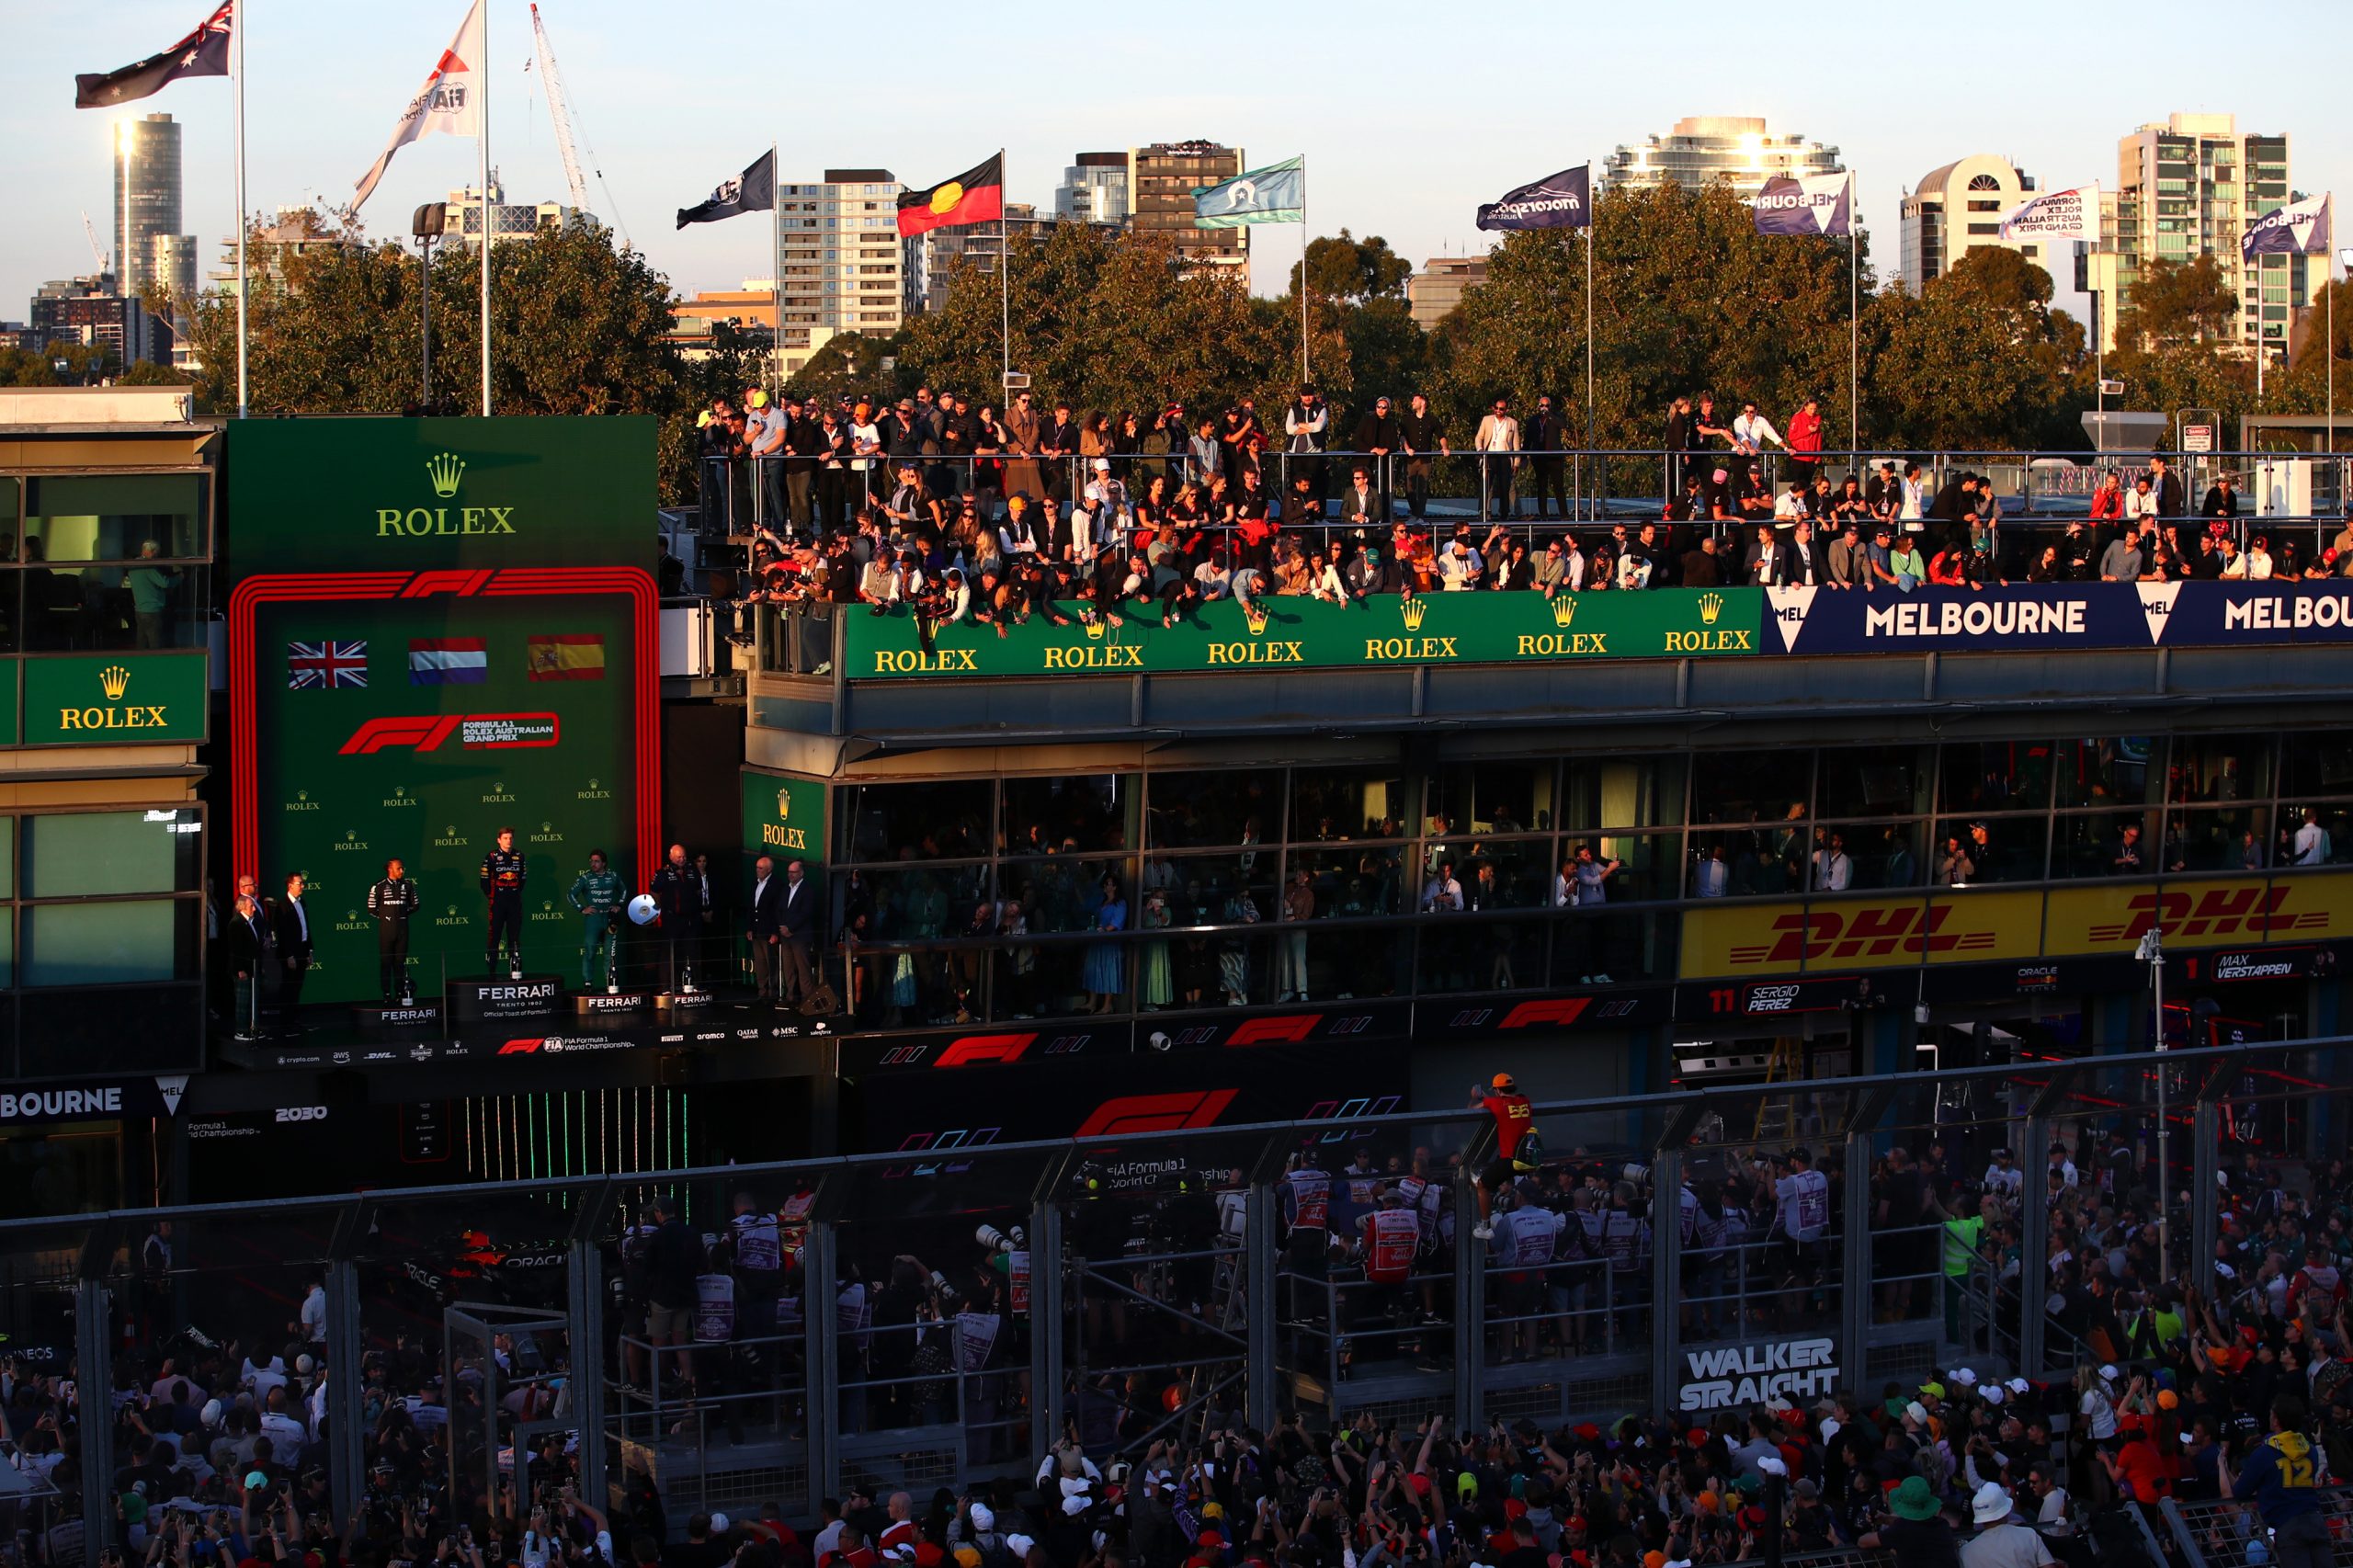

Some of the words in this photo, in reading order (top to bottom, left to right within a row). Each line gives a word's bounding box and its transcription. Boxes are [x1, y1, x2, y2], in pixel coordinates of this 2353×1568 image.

[376, 507, 517, 536] ROLEX
[1775, 608, 1804, 622] MEL
[2143, 602, 2171, 615] MEL
[1865, 600, 2086, 637] MELBOURNE
[1517, 633, 1608, 655] ROLEX
[1664, 630, 1751, 652] ROLEX
[1207, 642, 1303, 664] ROLEX
[1364, 637, 1458, 660] ROLEX
[874, 649, 978, 672] ROLEX
[1044, 645, 1143, 668] ROLEX
[60, 706, 167, 730] ROLEX
[462, 721, 508, 729] FORMULA
[462, 727, 494, 735] ROLEX
[494, 725, 553, 734] AUSTRALIAN
[462, 734, 495, 743] GRAND
[483, 793, 516, 802] ROLEX
[577, 790, 610, 799] ROLEX
[286, 801, 320, 811] ROLEX
[383, 798, 417, 807] ROLEX
[435, 837, 468, 846] ROLEX
[530, 834, 563, 842] ROLEX
[763, 824, 806, 849] ROLEX
[335, 842, 368, 851] ROLEX
[531, 912, 564, 921] ROLEX
[2120, 886, 2300, 941] DHL
[336, 922, 370, 930] ROLEX
[436, 916, 469, 926] ROLEX
[1766, 905, 1961, 962] DHL
[2219, 954, 2249, 967] MAX
[2018, 967, 2058, 976] ORACLE
[2186, 957, 2200, 981] 1
[2217, 962, 2292, 979] VERSTAPPEN
[478, 983, 554, 1000] FERRARI
[1752, 984, 1800, 999] SERGIO
[588, 996, 642, 1007] FERRARI
[675, 994, 713, 1005] FERRARI
[1709, 988, 1735, 1014] 11
[1748, 997, 1792, 1012] PEREZ
[381, 1008, 436, 1020] FERRARI
[737, 1028, 758, 1038] QATAR
[780, 1027, 799, 1035] MSC
[585, 1041, 631, 1051] Championship
[286, 1056, 320, 1064] crypto.com
[161, 1087, 184, 1096] MEL
[0, 1087, 122, 1118] BOURNE
[276, 1106, 327, 1122] 2030
[188, 1122, 221, 1131] Formula
[199, 1128, 255, 1139] Championship
[1129, 1159, 1176, 1176] Formula
[1179, 1157, 1187, 1170] 1
[1688, 1337, 1834, 1379] WALKER
[1679, 1367, 1839, 1411] STRAIGHT
[2275, 1457, 2313, 1488] 12
